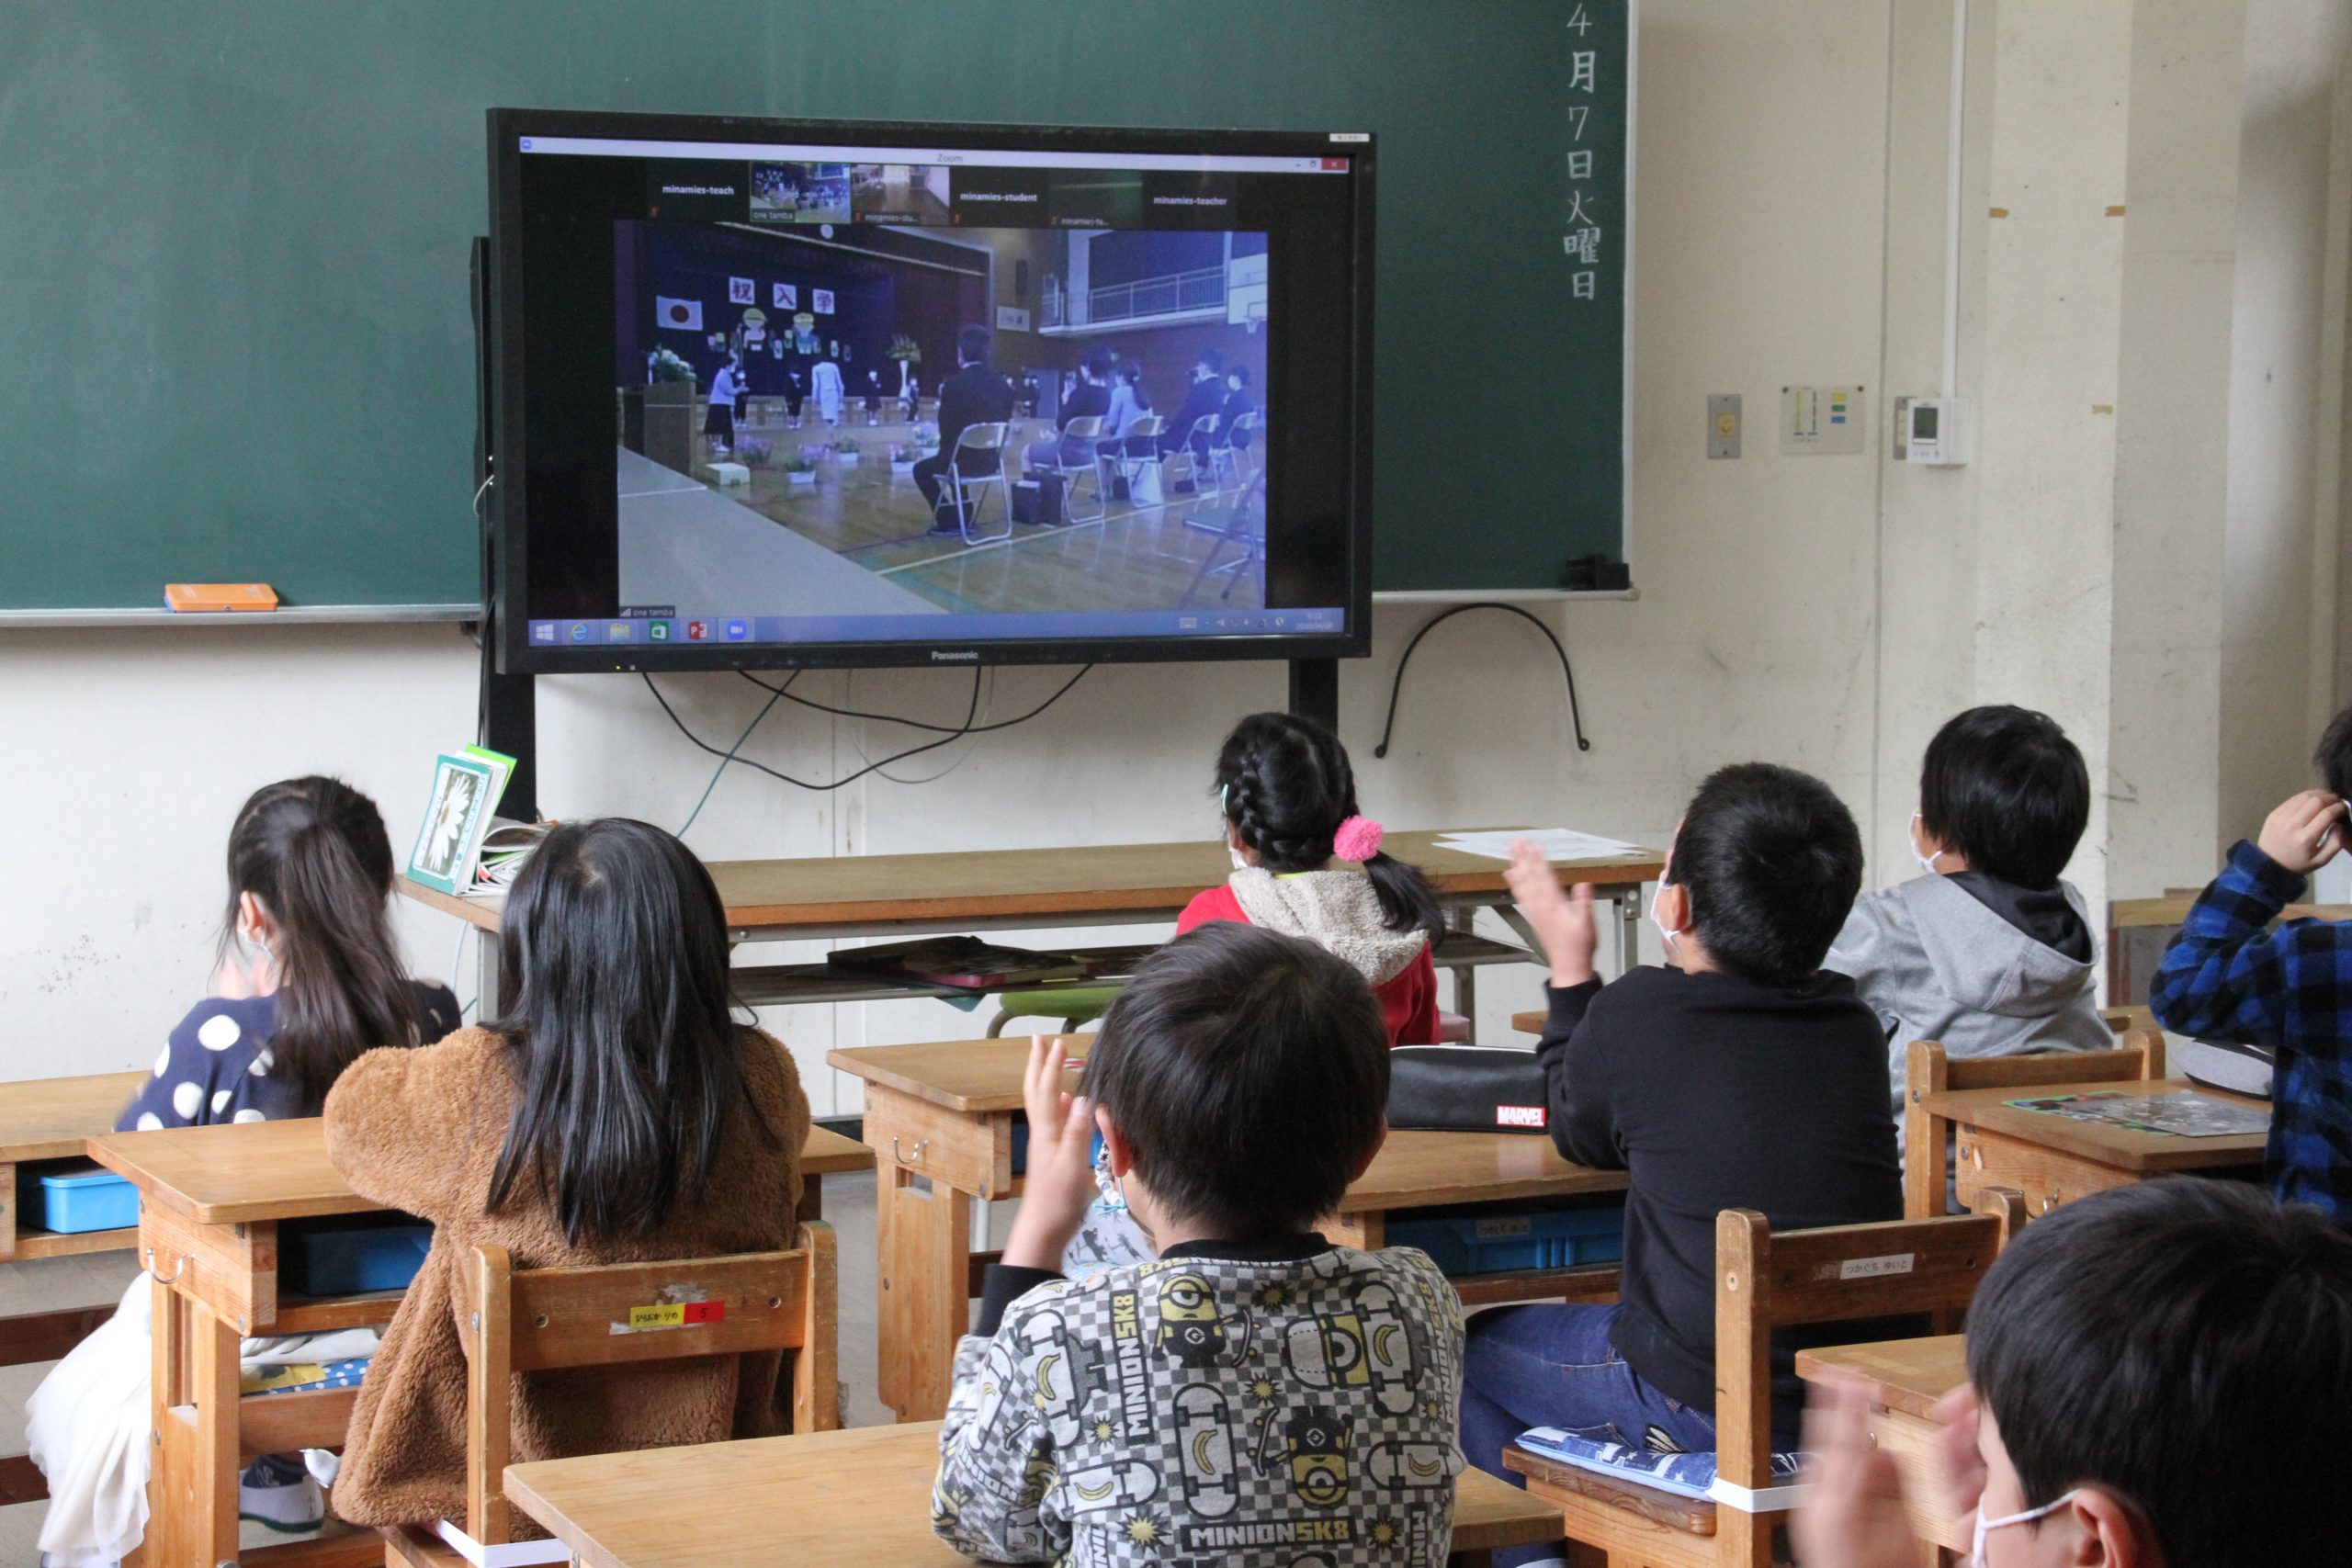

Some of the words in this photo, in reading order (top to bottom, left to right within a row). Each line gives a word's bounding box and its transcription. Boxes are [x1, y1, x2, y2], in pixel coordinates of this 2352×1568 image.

[1563, 3, 1600, 299] 4月7日火曜日
[937, 153, 963, 164] Zoom
[662, 184, 734, 196] minamies-teach
[960, 191, 1037, 202] minamies-student
[1153, 196, 1227, 207] minamies-teacher
[931, 650, 978, 660] Panasonic
[1497, 1106, 1544, 1127] MARVEL
[698, 1307, 709, 1319] 5
[1113, 1293, 1150, 1437] MINIONSK8
[1190, 1520, 1350, 1548] MINIONSK8
